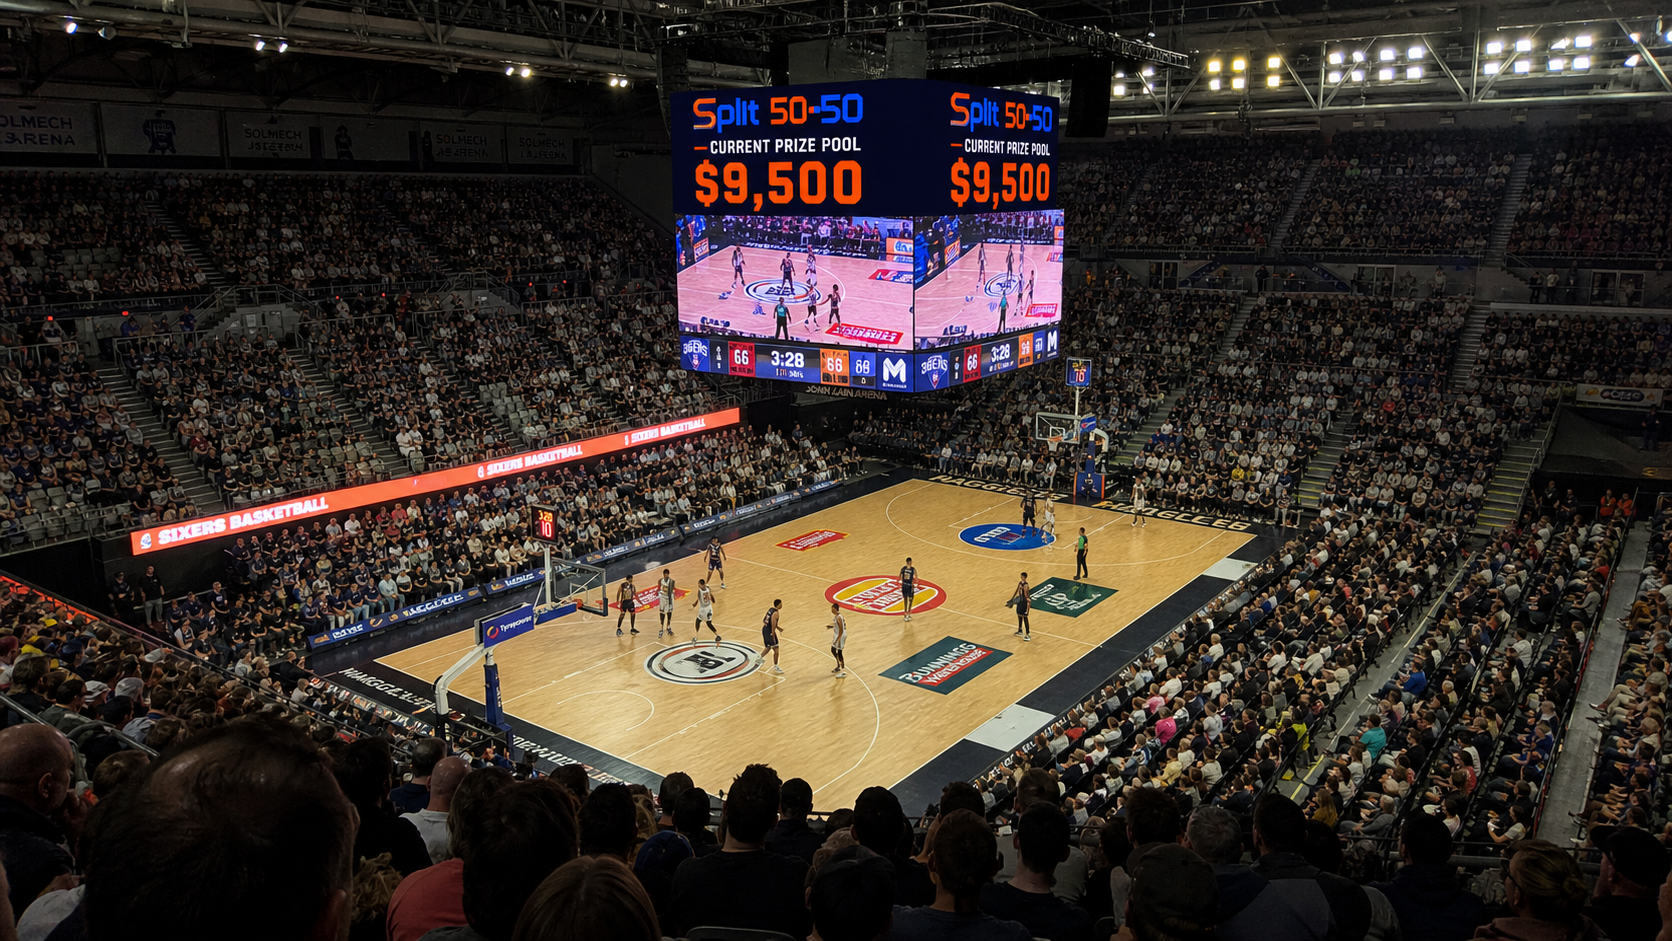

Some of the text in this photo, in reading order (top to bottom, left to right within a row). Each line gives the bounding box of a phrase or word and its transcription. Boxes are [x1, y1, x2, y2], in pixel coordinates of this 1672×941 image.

[693, 93, 863, 133] Split 50-50
[950, 92, 1052, 132] Split 50-50
[710, 137, 861, 154] CURRENT PRIZE POOL
[964, 138, 1051, 156] CURRENT PRIZE POOL
[695, 159, 862, 212] $9,500
[951, 157, 1050, 210] $9,500
[734, 349, 749, 365] 66
[771, 350, 805, 368] 3:28
[967, 353, 978, 371] 66
[158, 497, 329, 545] SIXERS BASKETBALL
